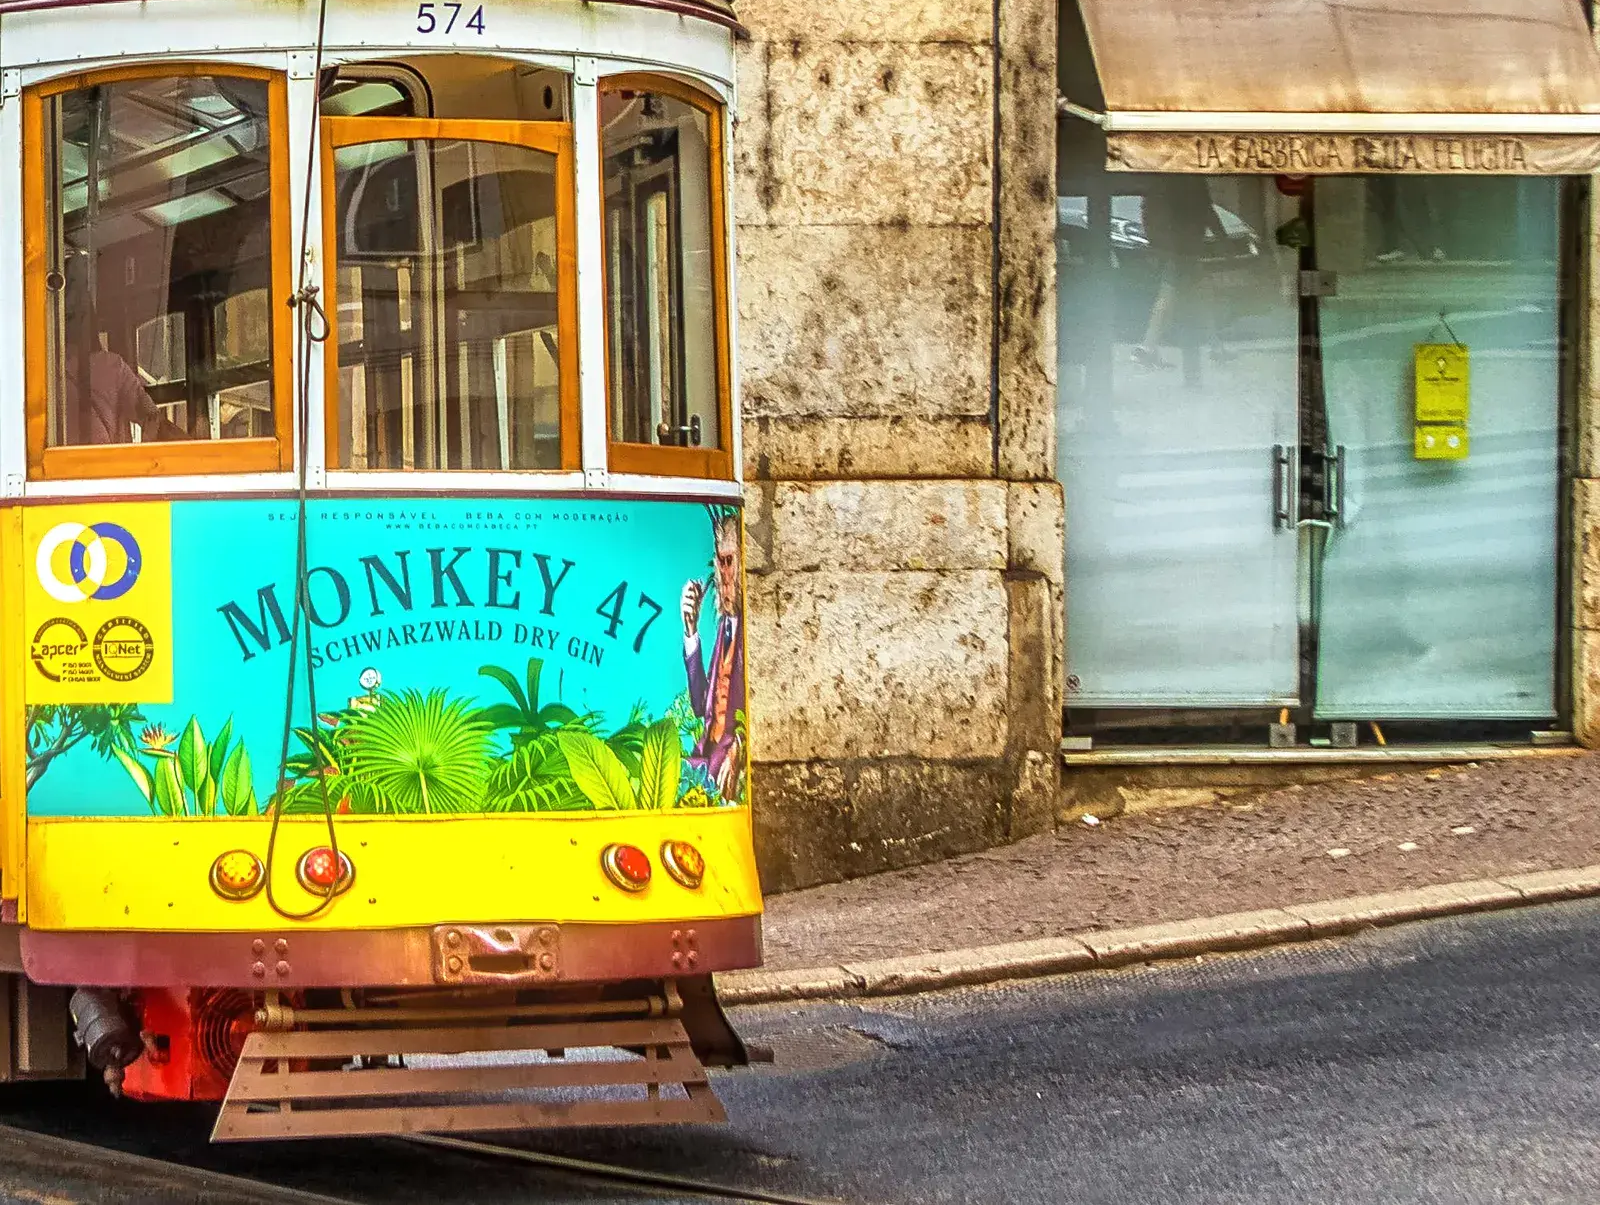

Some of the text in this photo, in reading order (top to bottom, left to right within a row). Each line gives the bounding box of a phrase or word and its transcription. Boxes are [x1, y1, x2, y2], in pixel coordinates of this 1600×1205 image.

[416, 2, 486, 35] 574
[1196, 137, 1223, 168] LA
[1233, 136, 1344, 169] FABBRICA
[268, 511, 629, 523] SEJ RESPONSÁVEL BEBA COM MODERAÇÃO
[216, 546, 663, 662] MONKEY 47
[41, 643, 79, 661] apcer
[104, 643, 141, 657] IQNet
[310, 619, 605, 669] SCHWARZWALD DRY GIN
